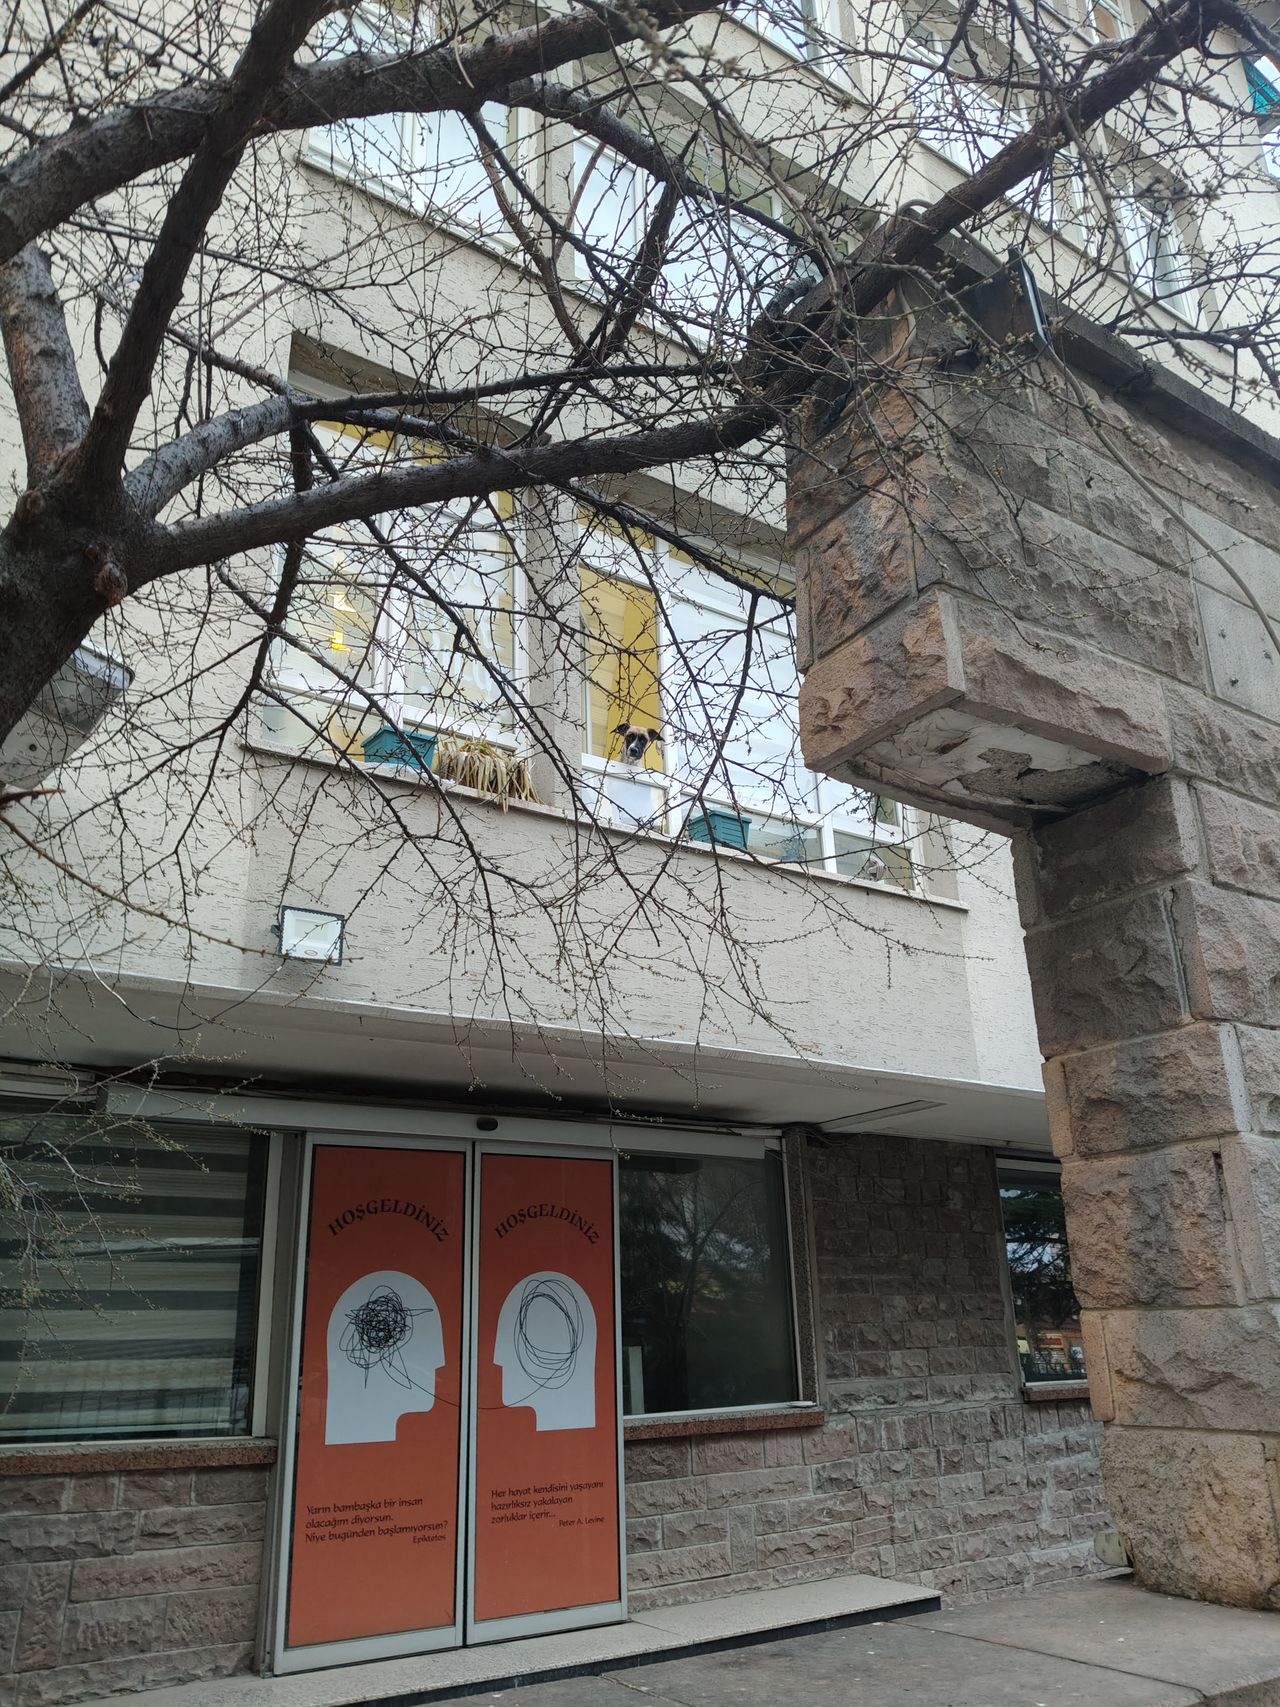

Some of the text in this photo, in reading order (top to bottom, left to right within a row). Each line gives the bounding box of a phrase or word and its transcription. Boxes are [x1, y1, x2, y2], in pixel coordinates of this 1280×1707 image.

[328, 1199, 450, 1242] HOŞGELDİNİZ
[494, 1203, 600, 1245] HOŞGELDİNİZ
[491, 1481, 604, 1499] Her hayat kendisini yaşayanı
[306, 1497, 423, 1515] Yarın bambaşka bir insan
[491, 1496, 573, 1511] hazırlıksız yakalayan
[305, 1514, 394, 1529] olacağım diyorsun.
[491, 1511, 527, 1524] zorluklar
[559, 1516, 604, 1528] Peter A. Levine
[305, 1520, 449, 1543] Niye bugünden başlamıyorsun?
[412, 1533, 447, 1544] Epiktetos
